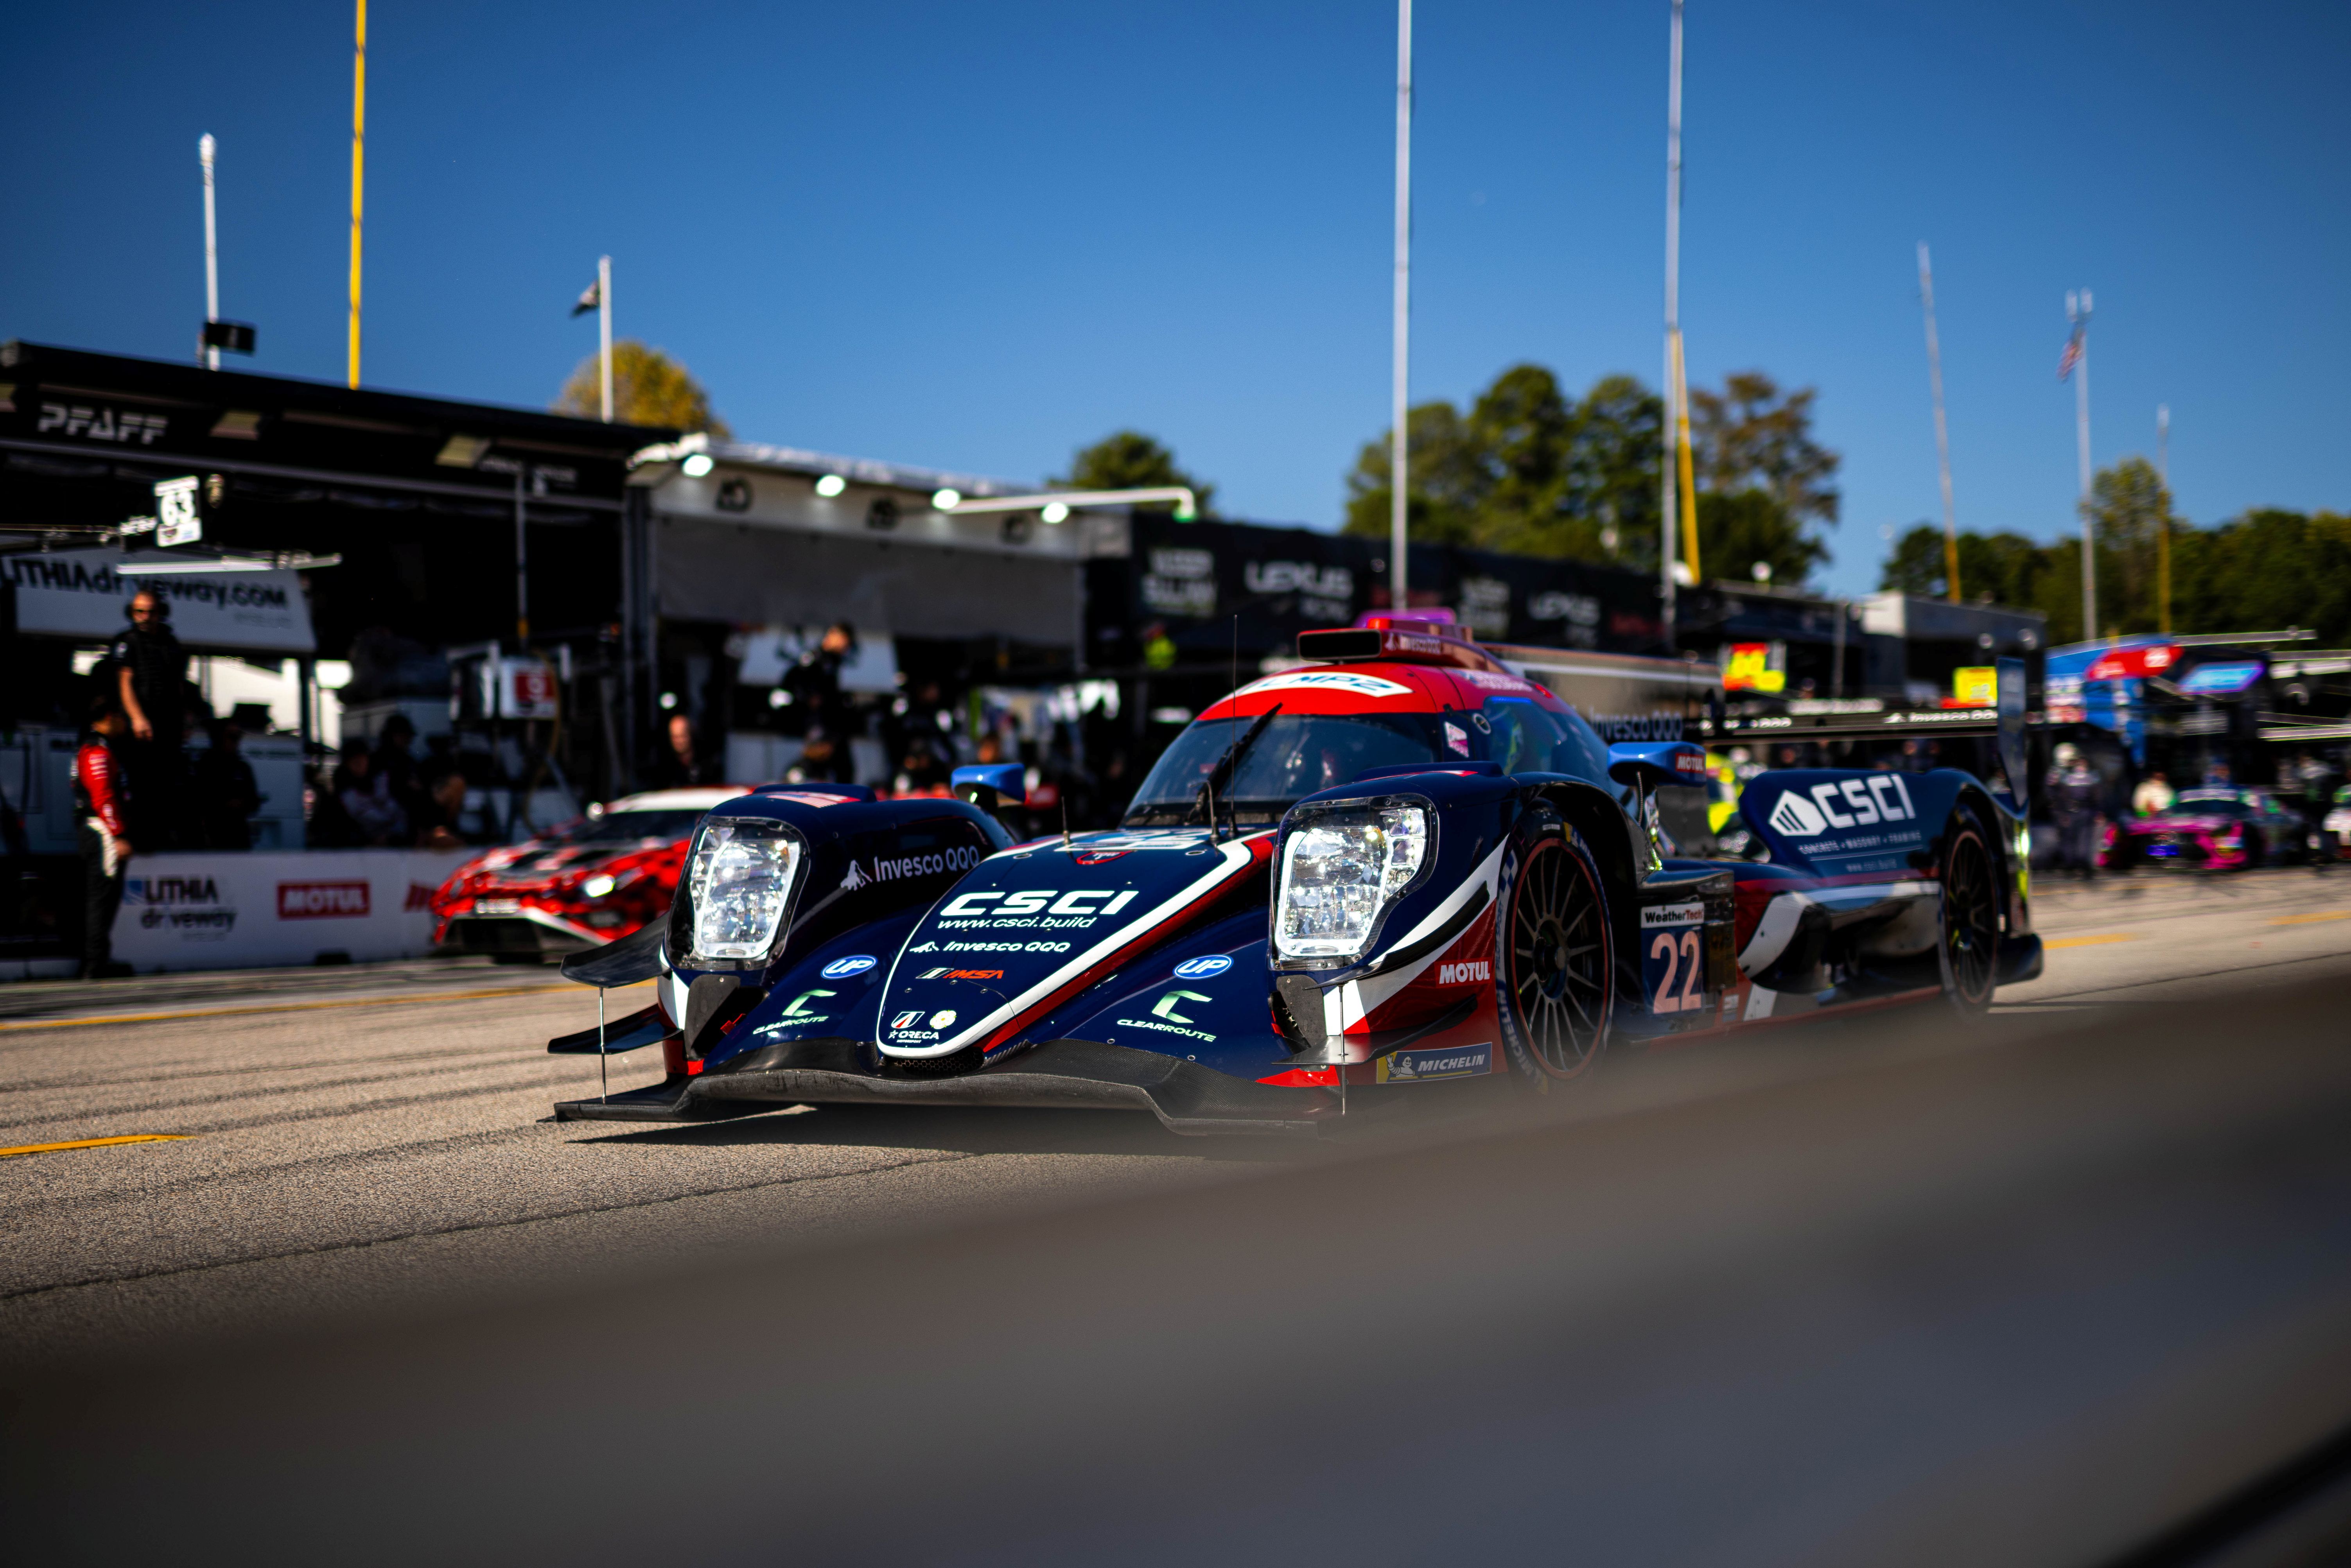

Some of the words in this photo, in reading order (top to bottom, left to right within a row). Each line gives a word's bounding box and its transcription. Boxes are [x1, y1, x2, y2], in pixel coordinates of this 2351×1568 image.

[39, 402, 168, 444] PFAFF
[161, 490, 196, 527] 63
[1259, 675, 1393, 691] LMP2
[1909, 712, 1970, 723] Invesco
[1676, 756, 1704, 772] MOTUL
[1811, 773, 1916, 829] CSCI
[874, 854, 943, 883] Invesco
[946, 845, 979, 871] QQQ
[146, 878, 218, 904] LITHIA
[284, 888, 364, 914] MOTUL
[940, 891, 1139, 916] CSCI
[937, 917, 1097, 929] www.csci.build
[1645, 910, 1703, 923] WeatherTech
[943, 941, 1023, 952] Invesco
[1023, 941, 1071, 953] QQQ
[826, 960, 873, 974] UP
[943, 970, 1003, 979] IMSA
[1177, 960, 1229, 974] UP
[1439, 961, 1490, 984] MOTUL
[1651, 930, 1702, 1014] 22
[753, 1016, 829, 1035] CLEARROUTE
[898, 1030, 939, 1039] ORECA
[1117, 1019, 1217, 1042] CLEARROUTE
[1417, 1053, 1486, 1072] MICHELIN
